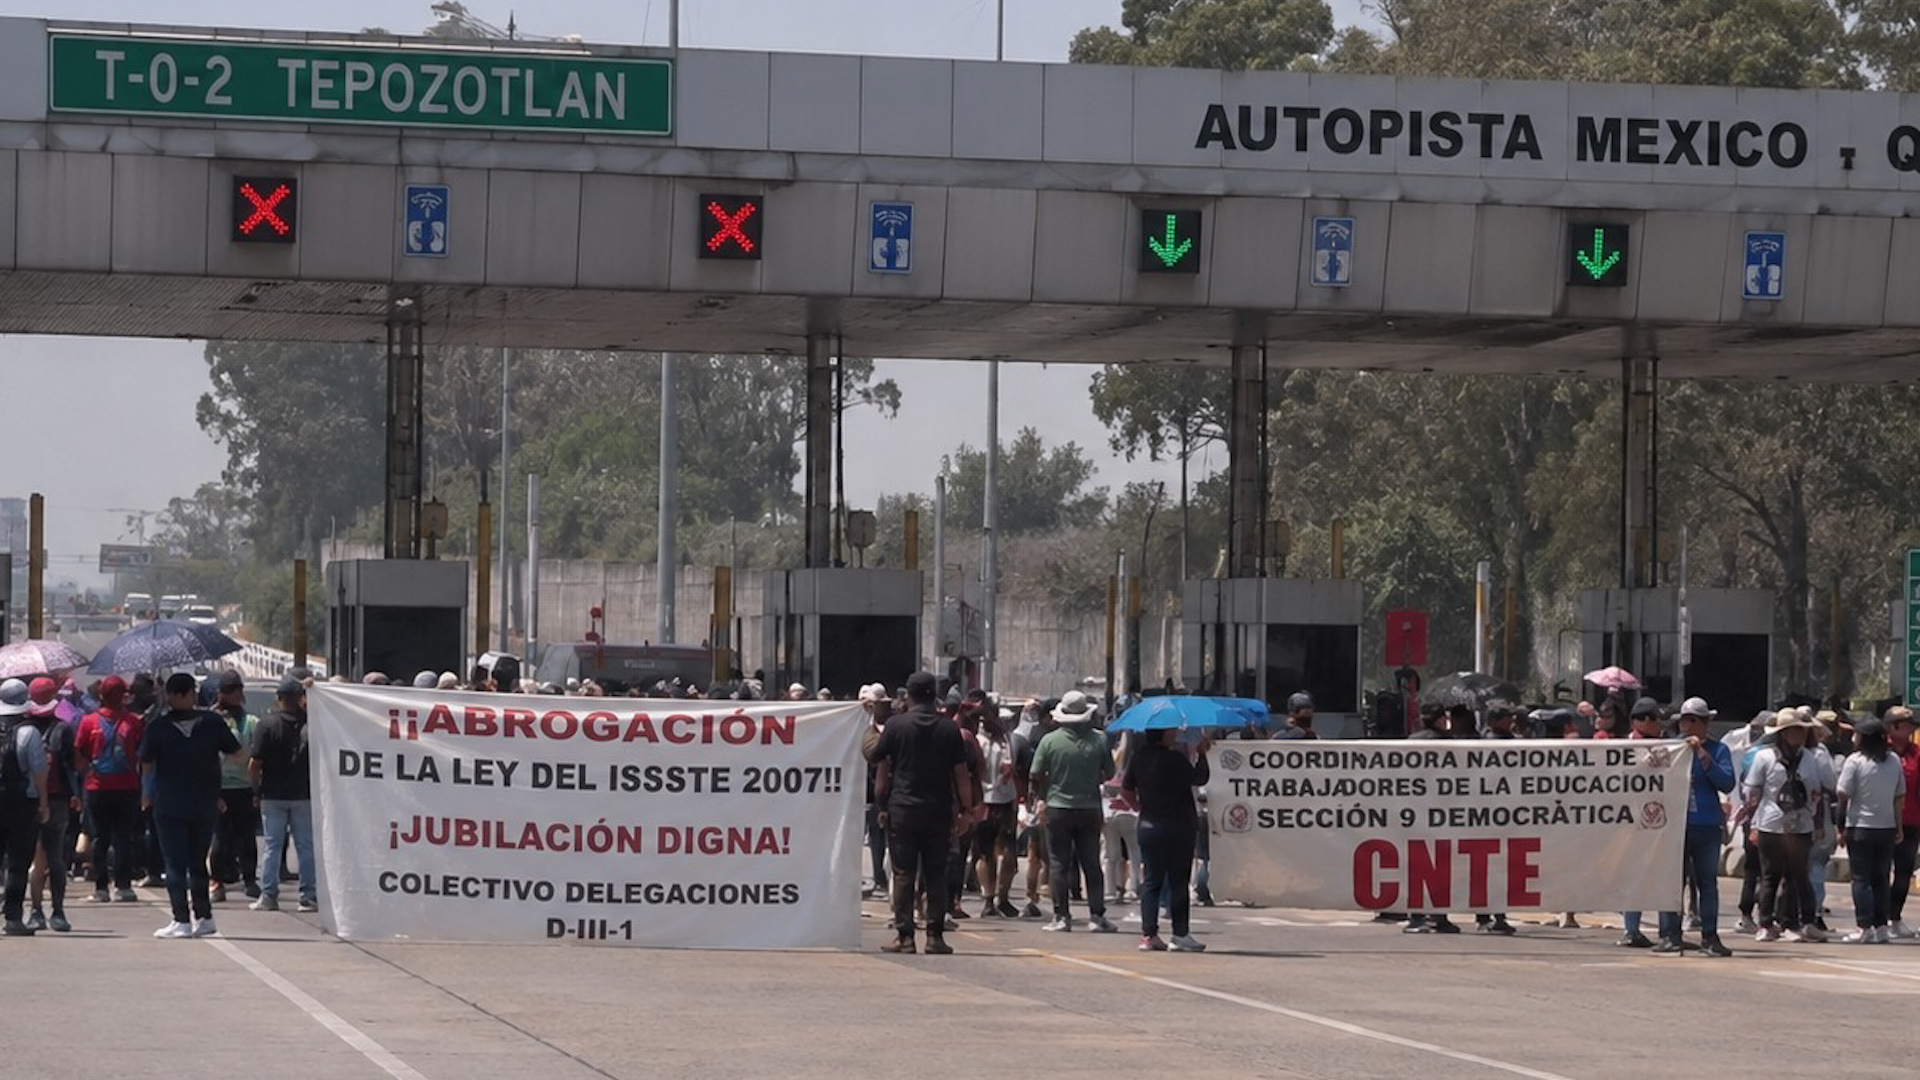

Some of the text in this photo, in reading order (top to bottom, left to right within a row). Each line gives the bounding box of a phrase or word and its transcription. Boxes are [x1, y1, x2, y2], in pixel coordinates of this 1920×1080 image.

[95, 49, 626, 120] T-0-2 TEPOZOTLAN
[1194, 103, 1543, 161] AUTOPISTA
[1576, 116, 1808, 169] MEXICO
[389, 703, 796, 745] ¡¡ABROGACIÓN
[339, 749, 842, 794] DE LA LEY DEL ISSSTE 2007!!
[1249, 747, 1637, 770] COORDINADORA NACIONAL DE
[1228, 774, 1664, 798] TRABAJADORES DE LA EDUCACION
[1257, 802, 1388, 829] SECCIÓN
[1399, 808, 1416, 828] 9
[390, 816, 791, 857] ¡JUBILACIÓN DIGNA!
[378, 871, 800, 905] COLECTIVO DELEGACIONES
[1353, 838, 1543, 910] CNTE
[546, 917, 632, 941] D-III-1
